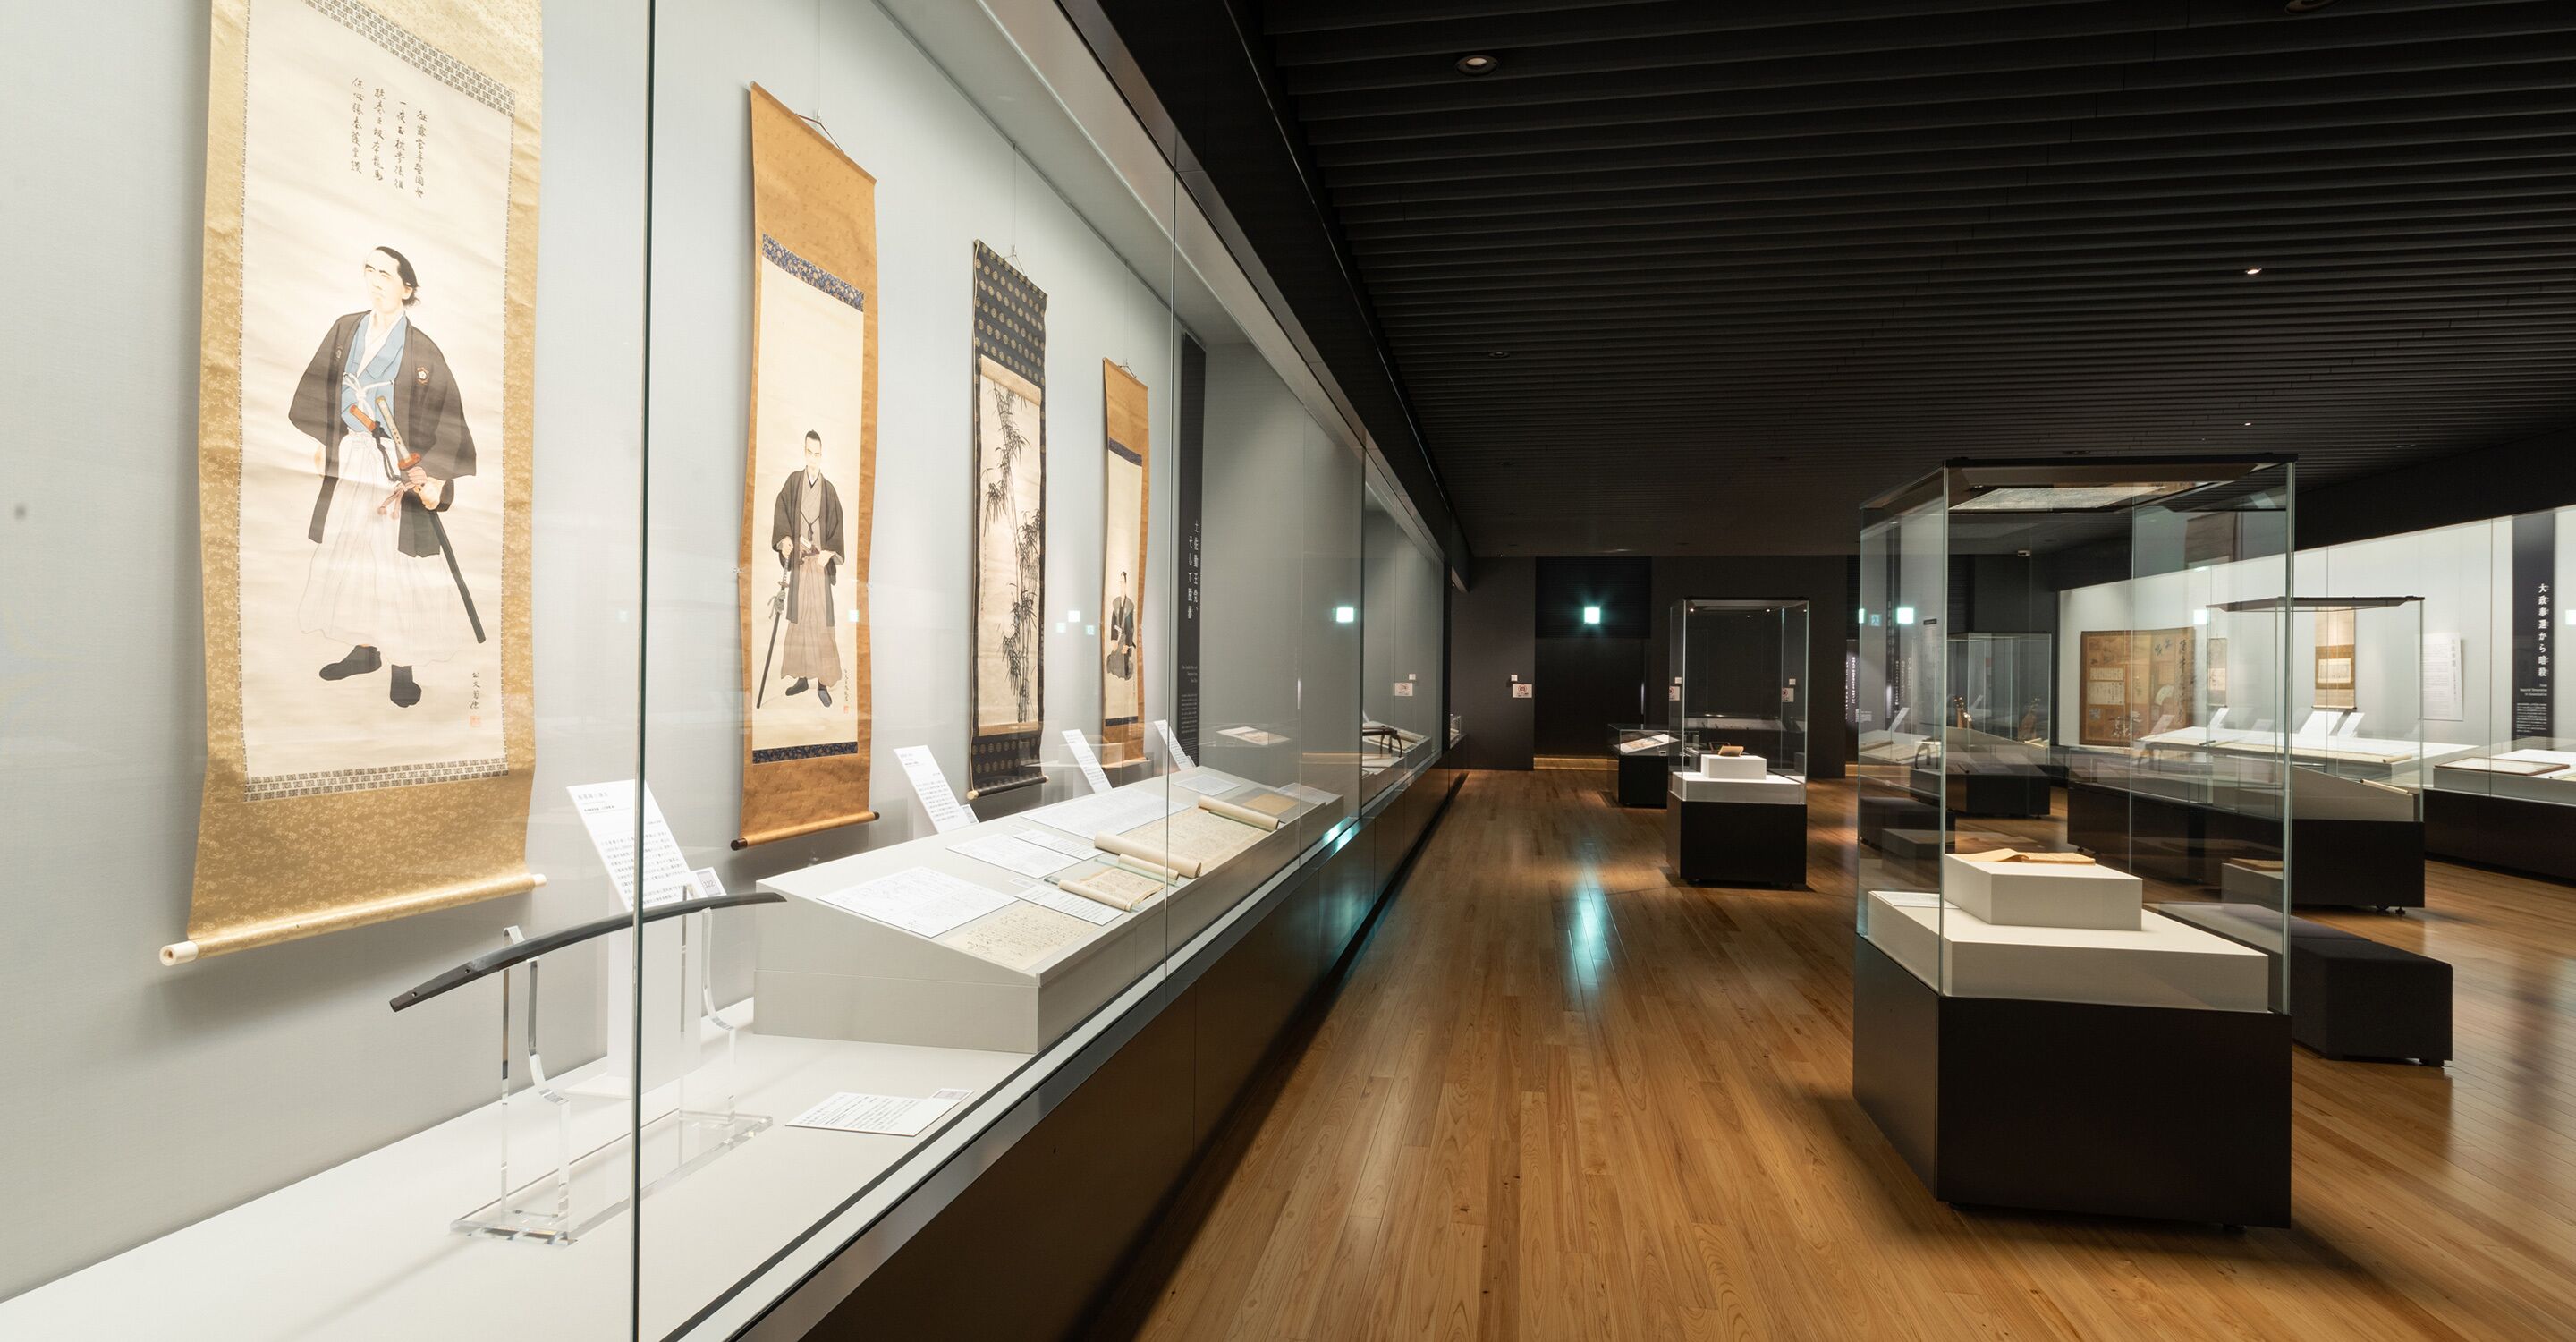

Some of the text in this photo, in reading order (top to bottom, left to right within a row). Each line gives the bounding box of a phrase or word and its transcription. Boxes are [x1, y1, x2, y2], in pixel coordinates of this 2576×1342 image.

[2538, 583, 2547, 677] 大政奉還から暗殺
